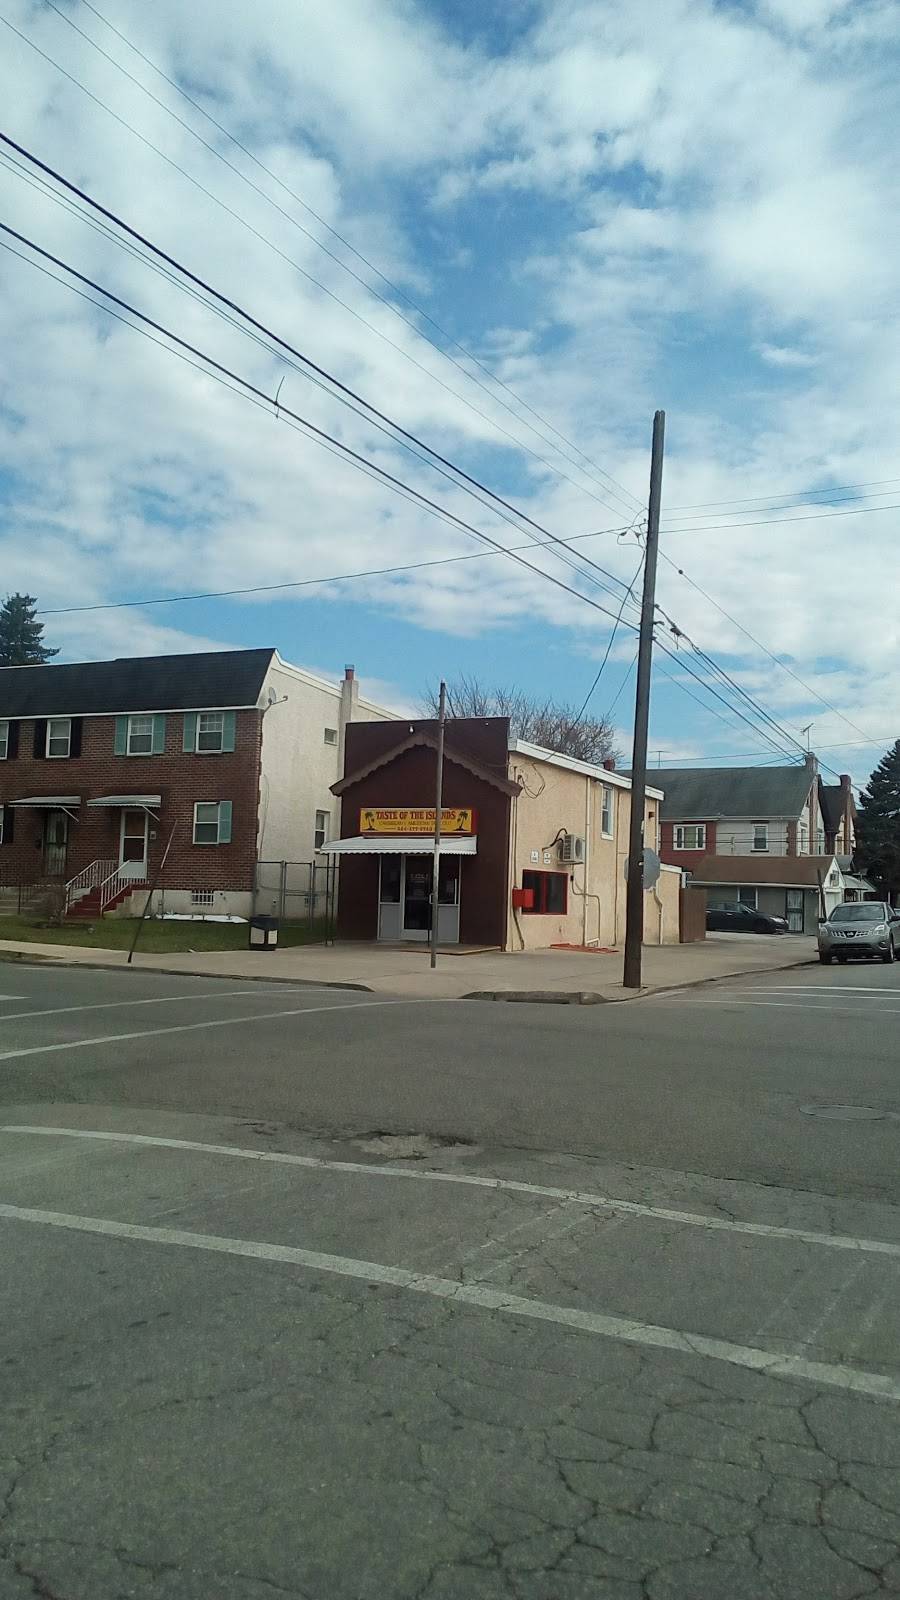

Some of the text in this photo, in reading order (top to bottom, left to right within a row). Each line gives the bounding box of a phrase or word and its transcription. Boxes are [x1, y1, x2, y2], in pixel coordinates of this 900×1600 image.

[375, 811, 457, 820] TASTE OF THE ISLNDS
